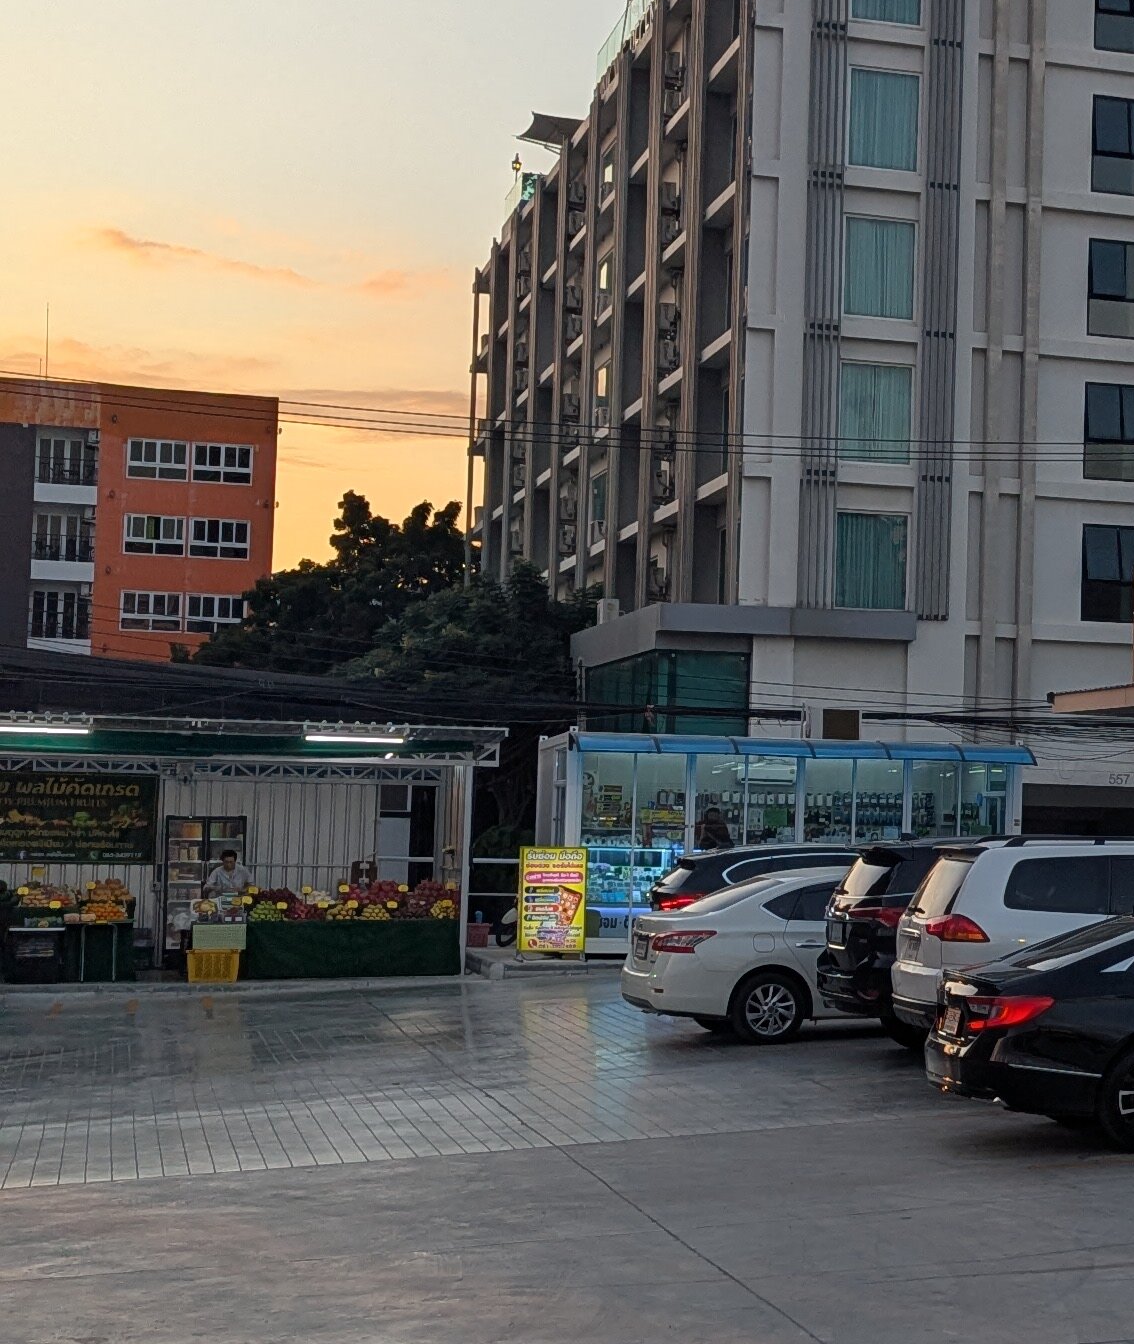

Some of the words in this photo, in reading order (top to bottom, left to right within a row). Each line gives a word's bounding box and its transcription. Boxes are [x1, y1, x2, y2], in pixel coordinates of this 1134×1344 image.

[1108, 773, 1131, 785] 557
[16, 776, 140, 797] ผลไม้คัดเกรด
[527, 850, 556, 860] รับซ่อม
[559, 850, 583, 860] มือถือ
